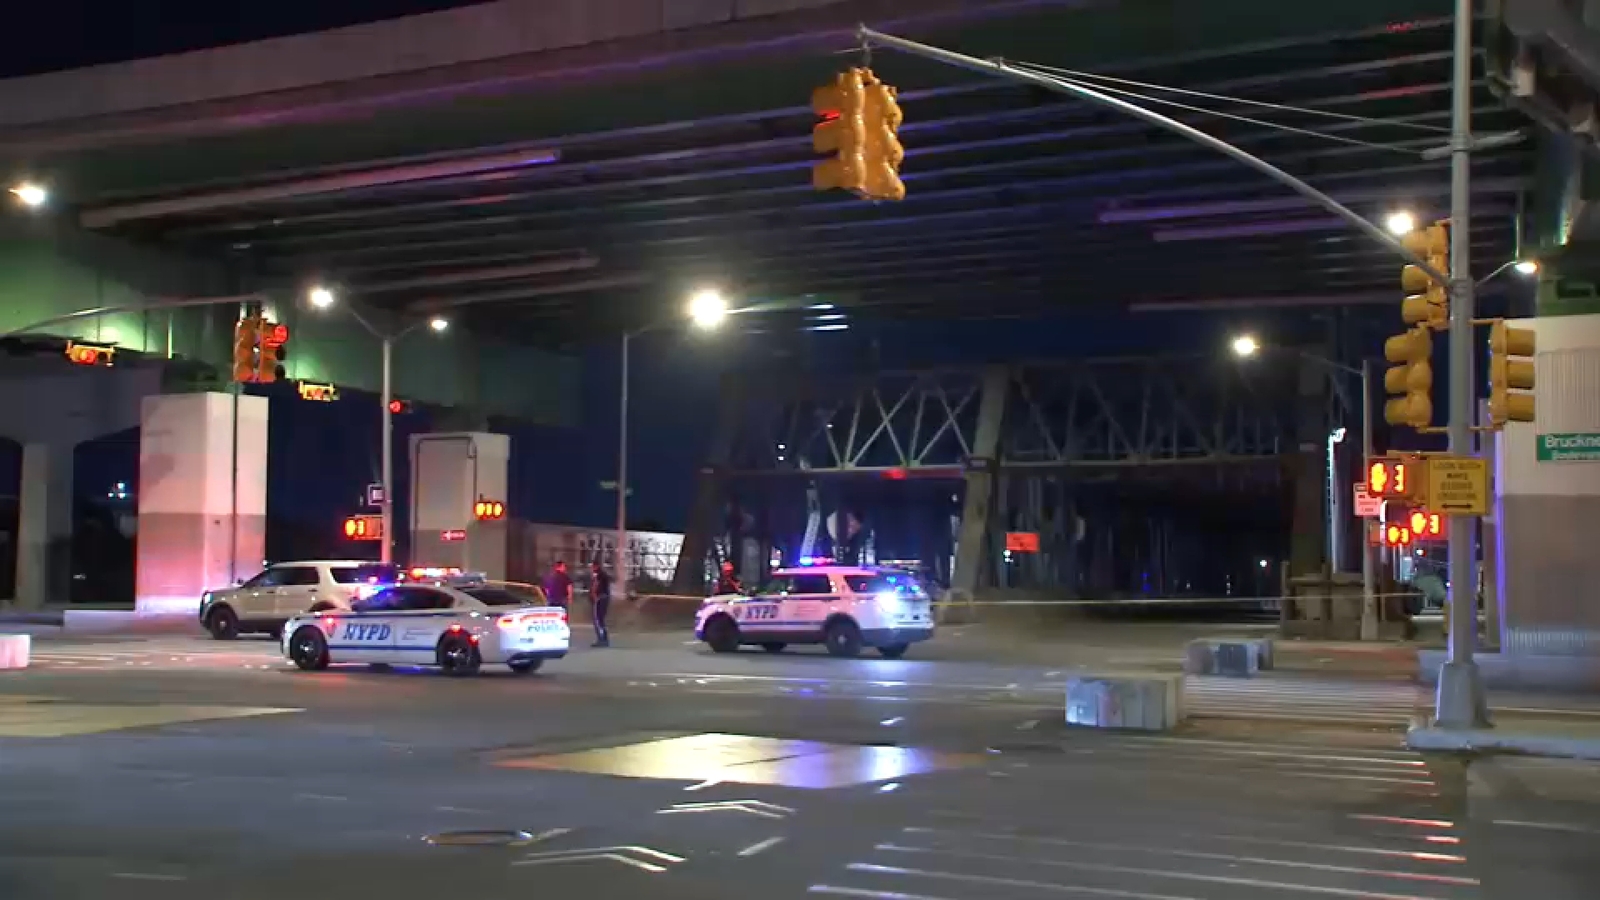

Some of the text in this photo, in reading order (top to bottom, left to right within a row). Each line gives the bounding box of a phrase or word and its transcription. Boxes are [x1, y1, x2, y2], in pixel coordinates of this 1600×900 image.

[1394, 464, 1405, 492] 3
[1429, 514, 1439, 534] 3
[744, 604, 779, 619] NYPD
[343, 622, 391, 641] NYPD
